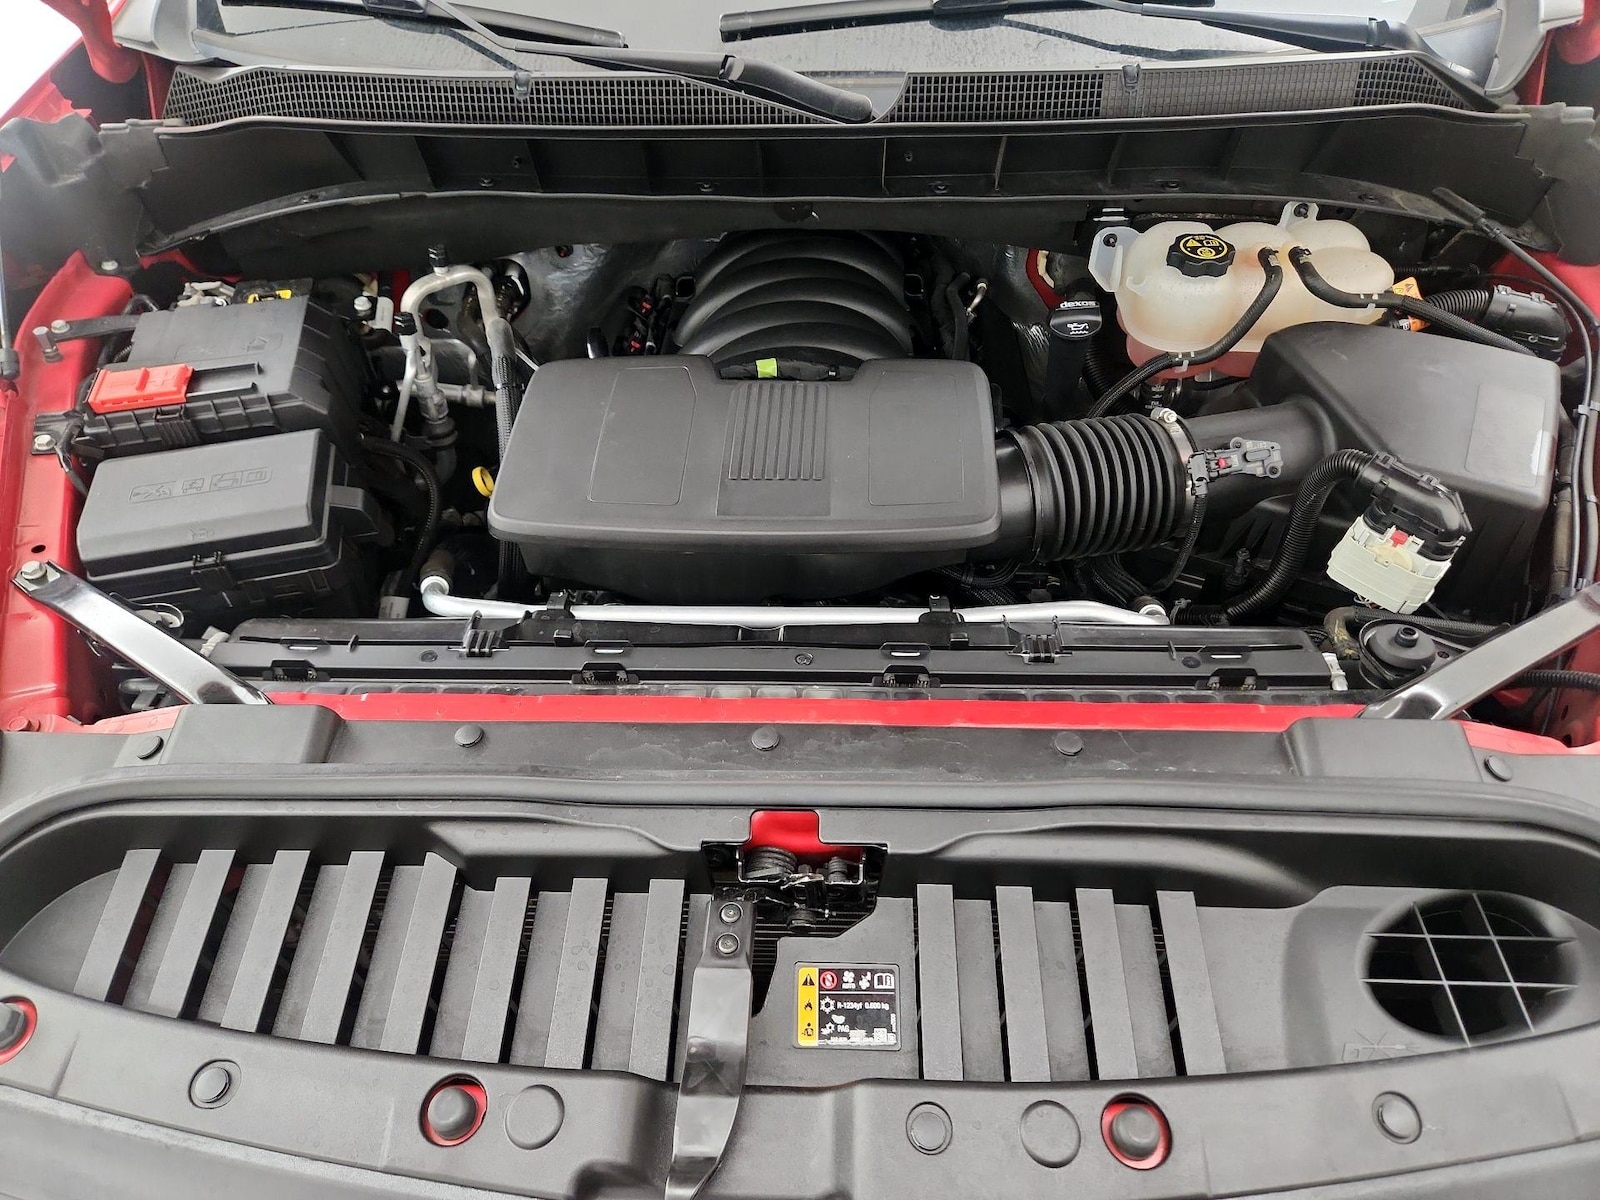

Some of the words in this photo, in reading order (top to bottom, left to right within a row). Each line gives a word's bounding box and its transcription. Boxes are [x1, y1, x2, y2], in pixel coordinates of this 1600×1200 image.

[1060, 300, 1096, 308] dexos
[837, 1001, 862, 1010] R-1234yf
[837, 1024, 850, 1033] PAG
